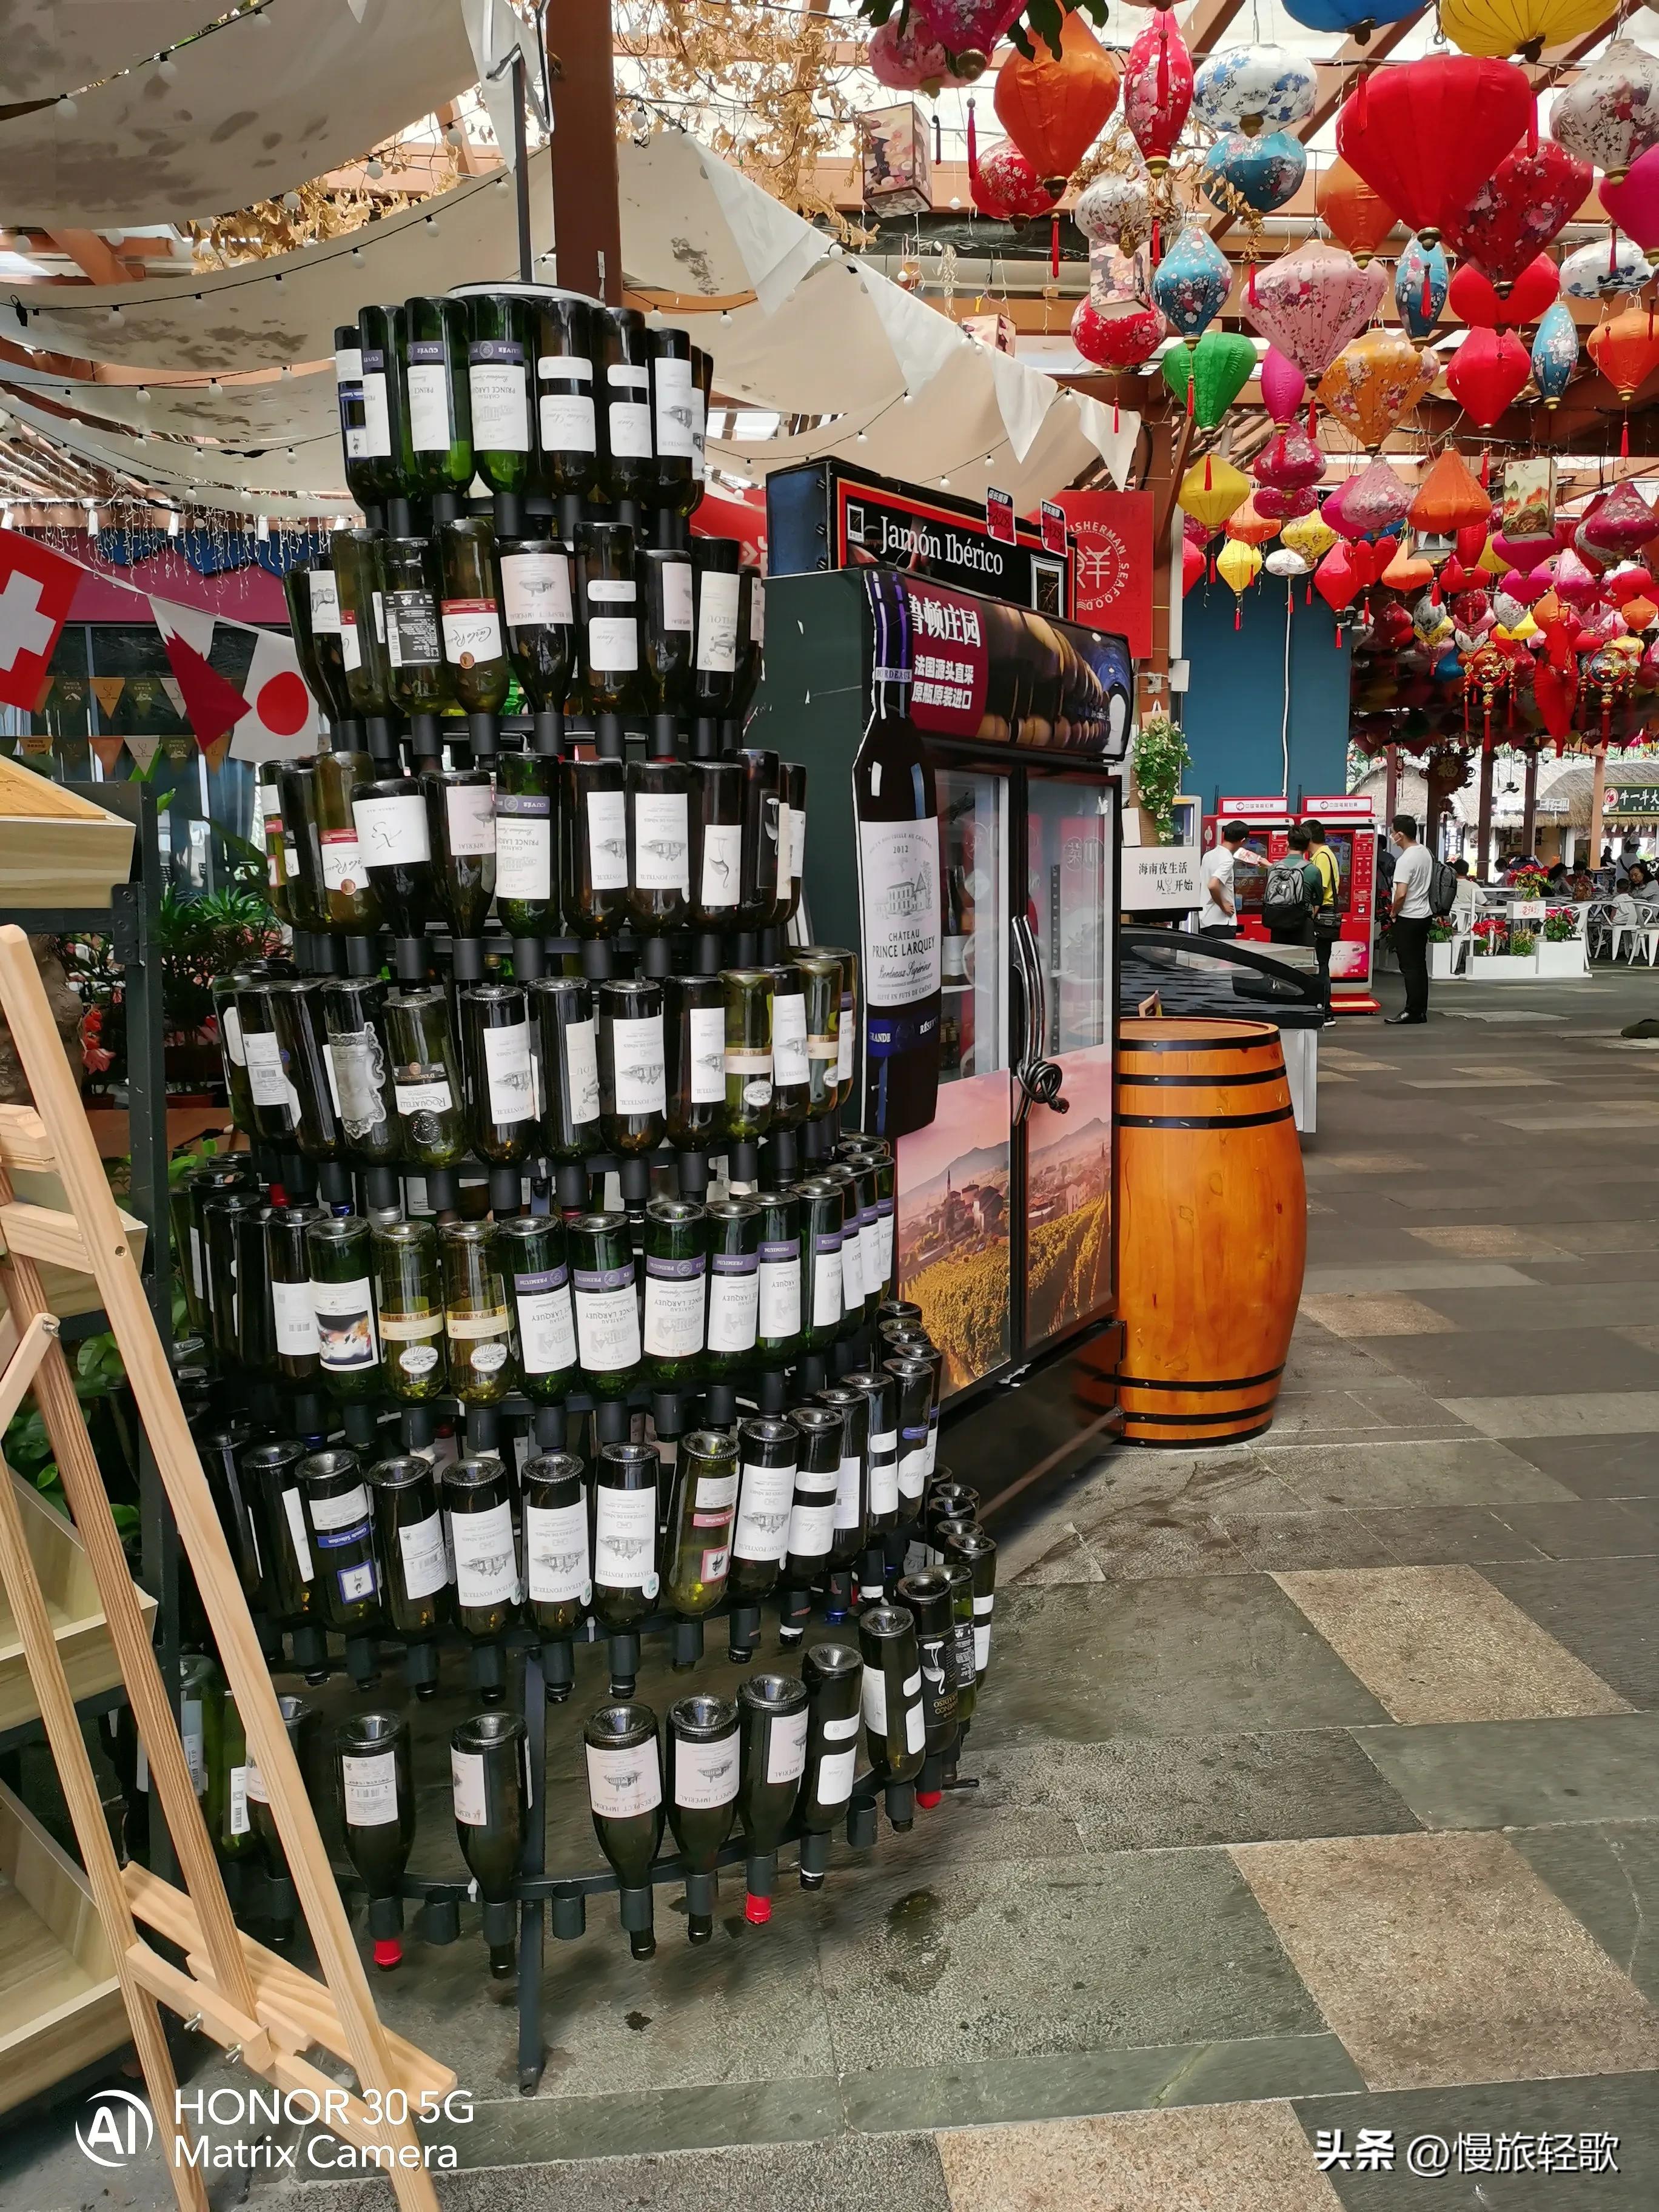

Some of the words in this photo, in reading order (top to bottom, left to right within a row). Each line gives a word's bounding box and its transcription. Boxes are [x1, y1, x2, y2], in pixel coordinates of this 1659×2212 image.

[880, 516, 942, 560] Jamón
[945, 534, 1004, 575] Ibérico
[1069, 520, 1127, 555] ISHERMAN
[914, 654, 974, 686] 法国源头直采
[911, 680, 973, 710] 原瓶原装进口
[893, 845, 909, 854] 2012
[1139, 862, 1188, 874] 海南夜生活
[1156, 880, 1165, 892] 从
[1175, 879, 1193, 892] 开始
[873, 945, 898, 958] PRINCE
[902, 935, 935, 956] LARQUEY
[532, 1309, 563, 1321] LARQUEY
[679, 1794, 711, 1803] IMPERIAL
